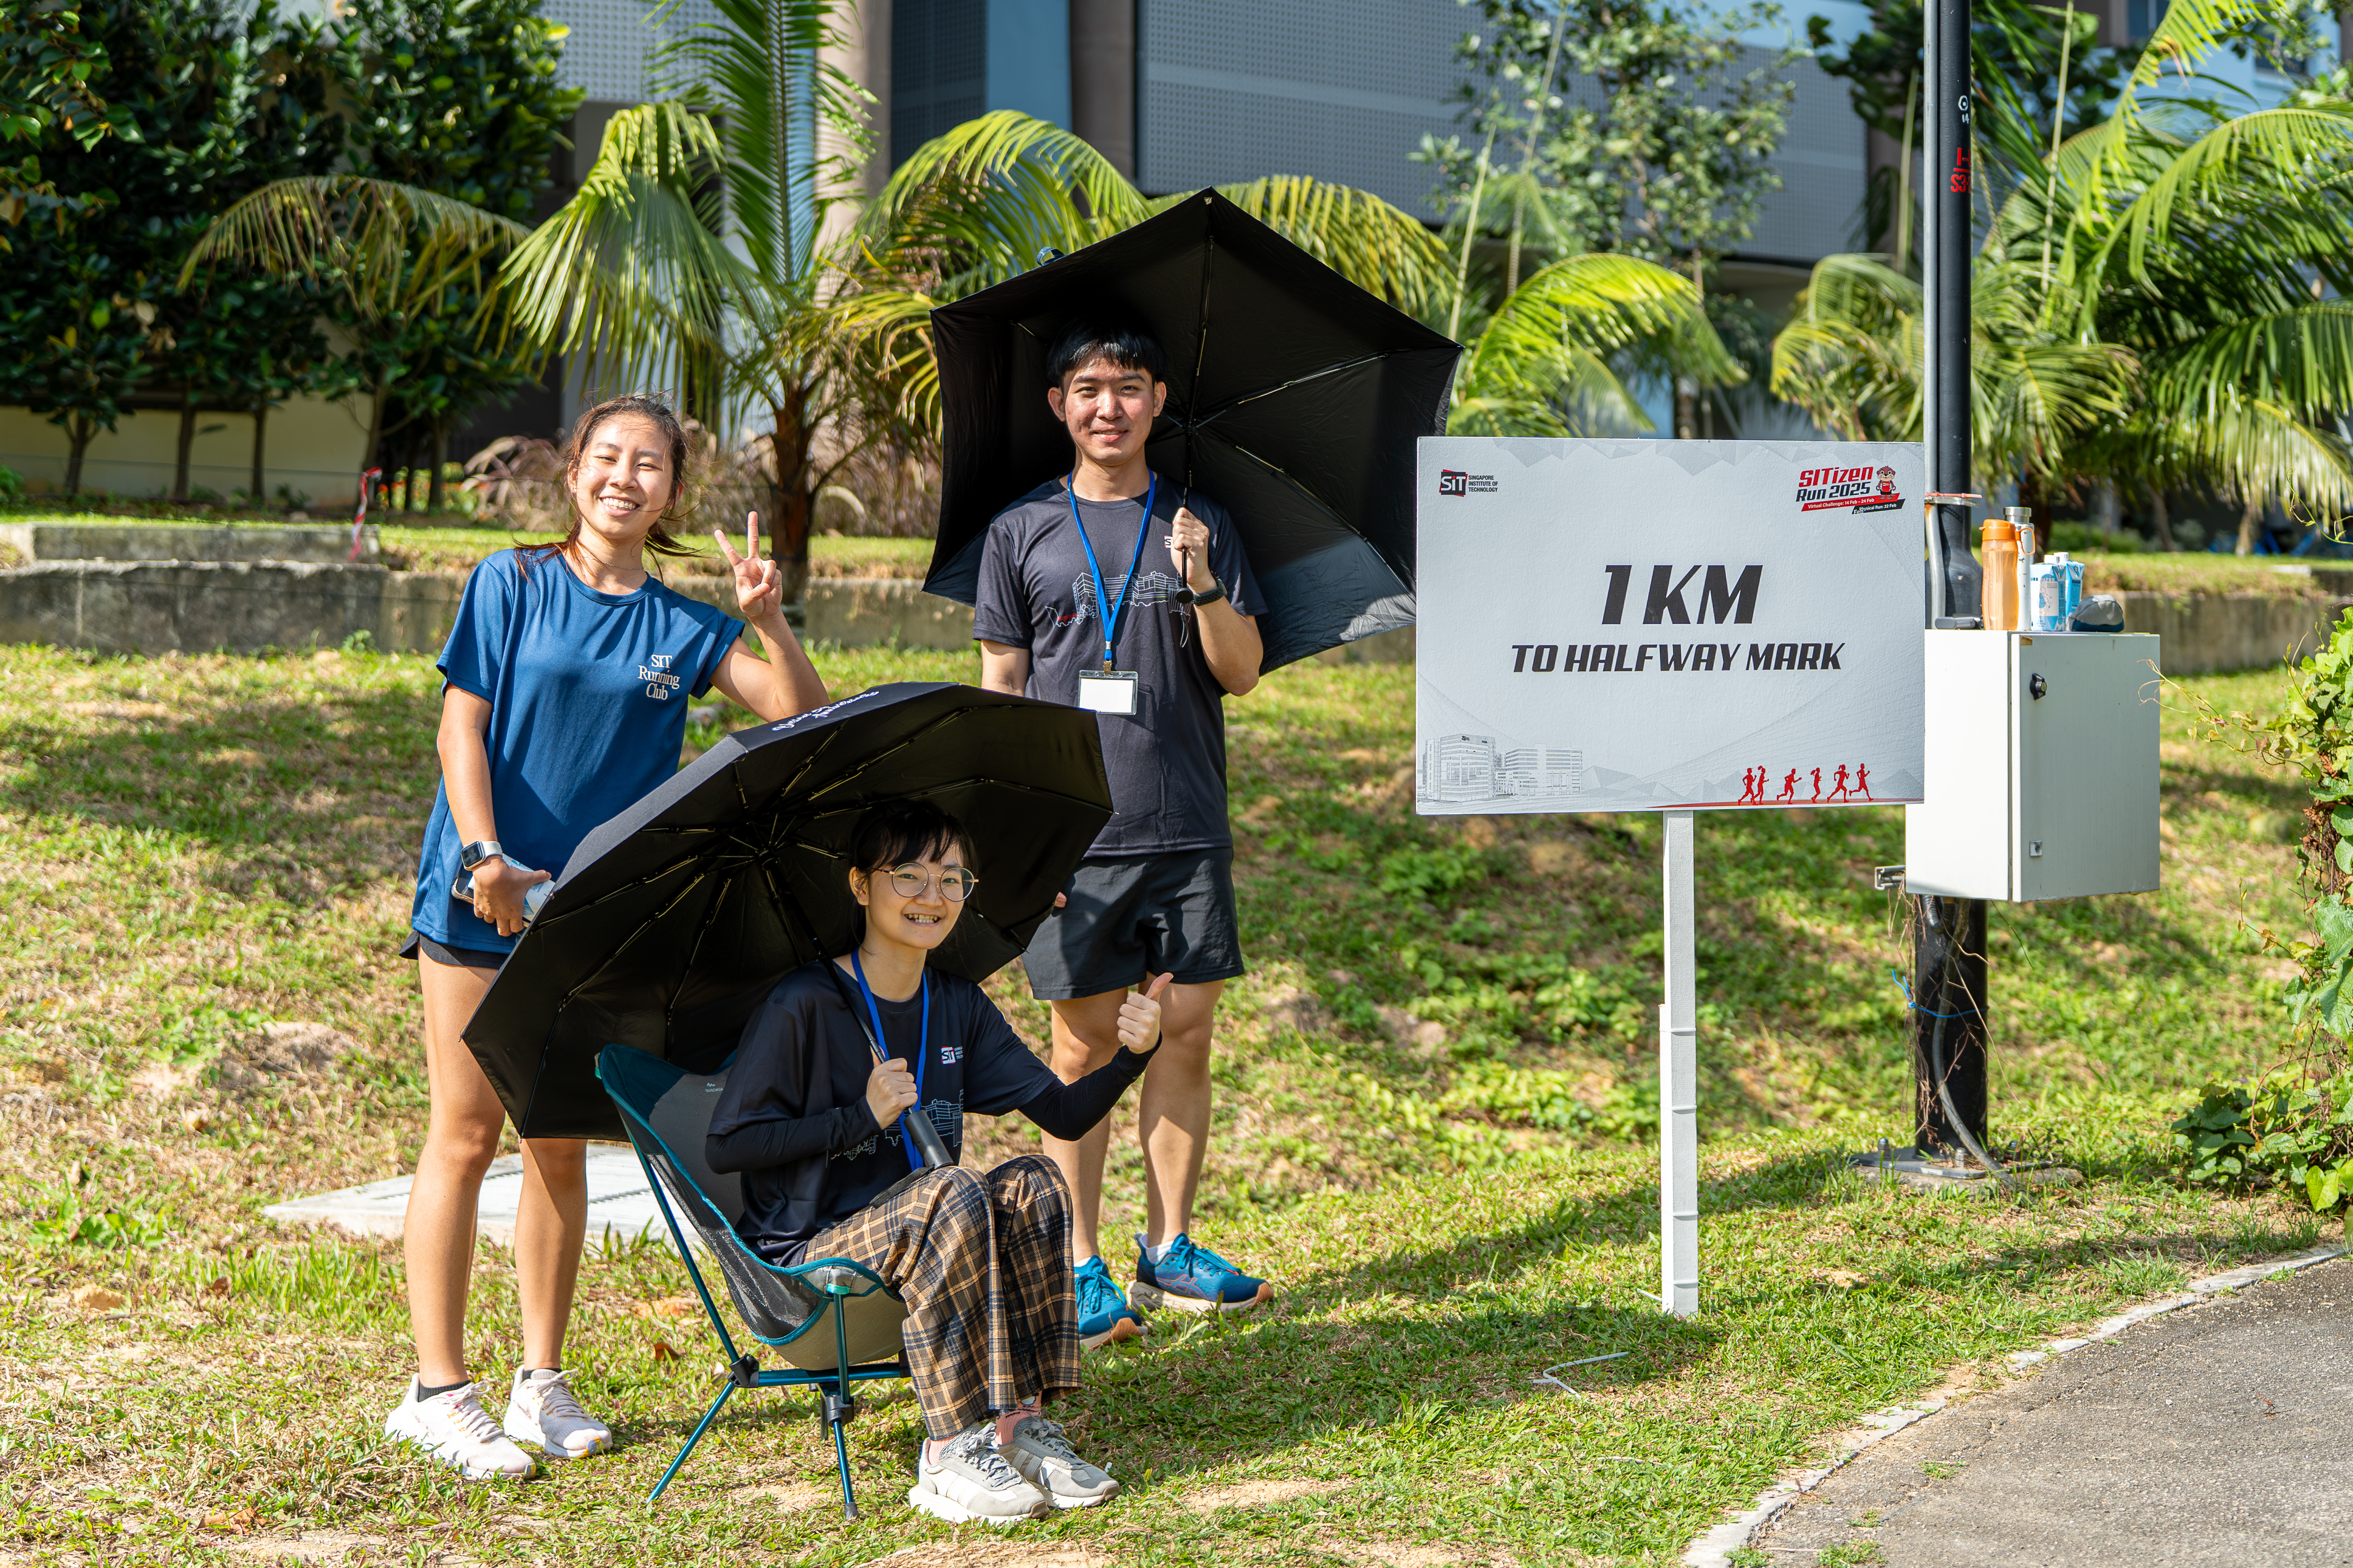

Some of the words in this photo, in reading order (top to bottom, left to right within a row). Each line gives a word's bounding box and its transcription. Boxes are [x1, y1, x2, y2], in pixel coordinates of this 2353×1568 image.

[1798, 467, 1874, 488] SITizen
[1796, 488, 1827, 502] Run
[1829, 481, 1871, 499] 2025
[1601, 564, 1632, 625] 1
[1642, 564, 1764, 625] KM
[651, 654, 673, 668] SIT
[1511, 645, 1559, 673] TO
[1563, 643, 1742, 673] HALFWAY
[1745, 642, 1846, 671] MARK
[637, 665, 681, 690] Running
[646, 682, 668, 700] Club
